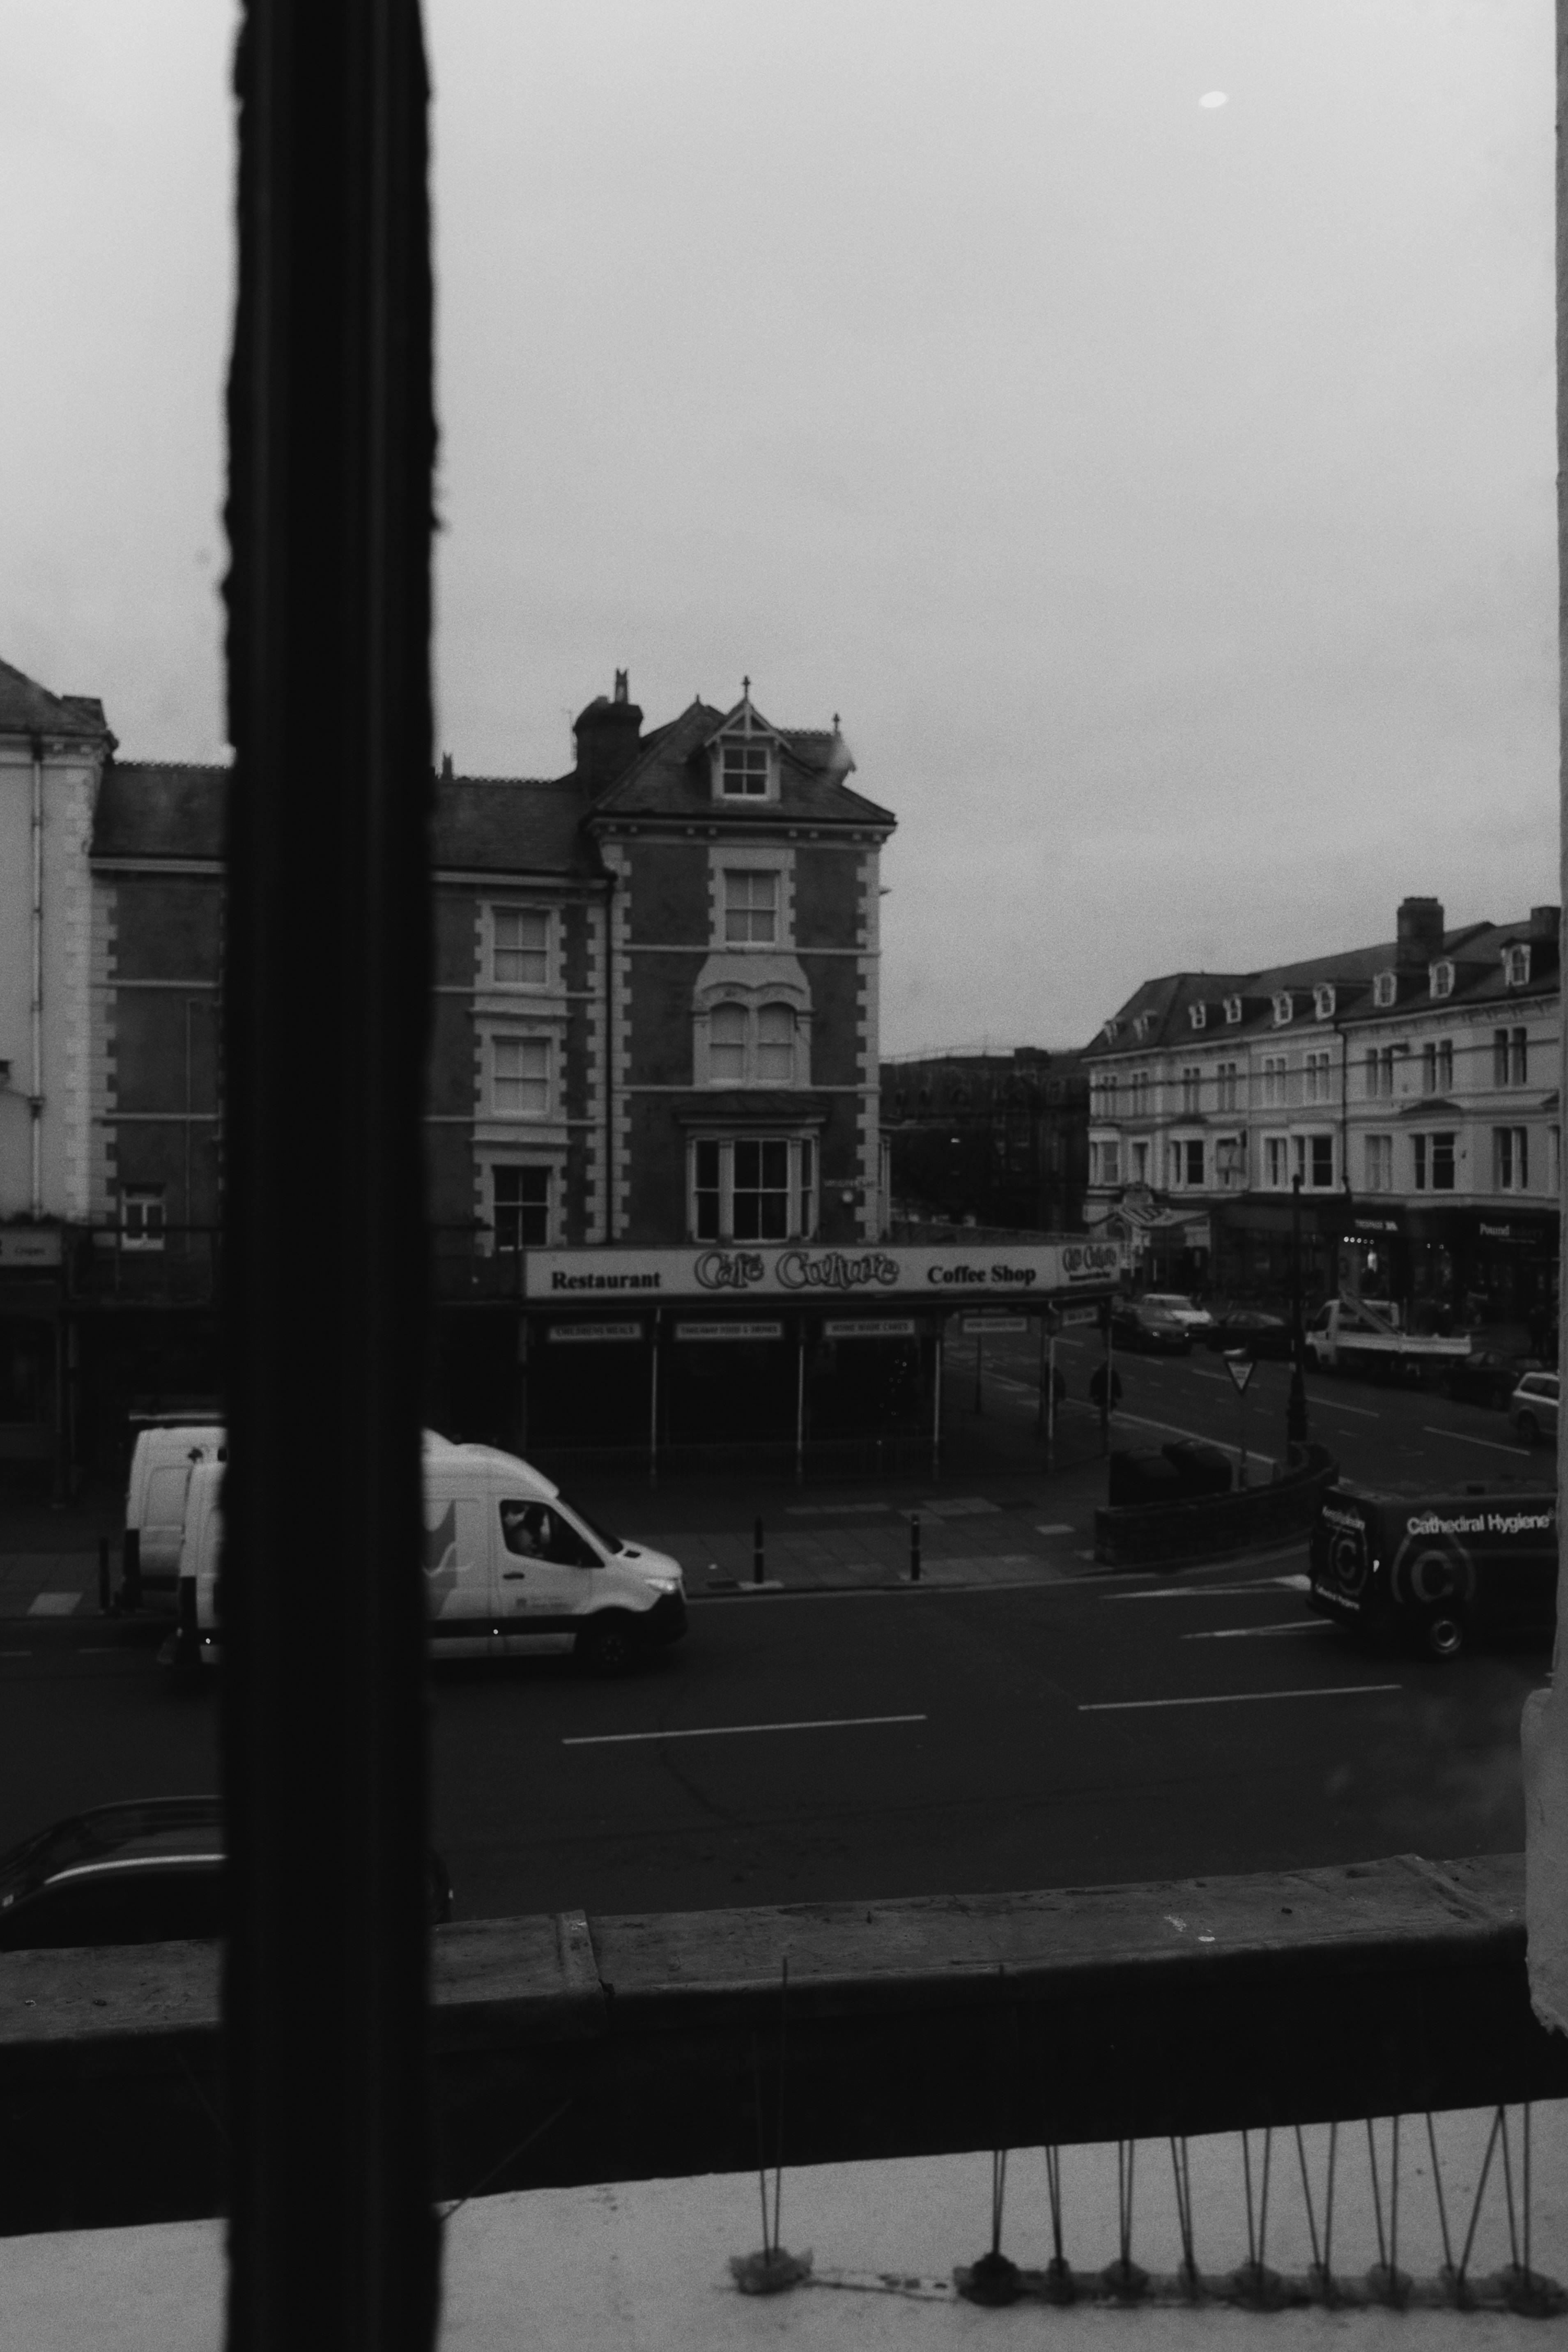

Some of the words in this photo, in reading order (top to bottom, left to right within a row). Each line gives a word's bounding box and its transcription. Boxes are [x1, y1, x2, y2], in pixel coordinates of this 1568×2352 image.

[552, 1271, 661, 1290] Restaurant
[775, 1251, 900, 1290] Culture
[927, 1265, 986, 1284] Coffee
[991, 1265, 1036, 1286] Shop
[1407, 1514, 1485, 1535] Cathedral
[1487, 1512, 1550, 1534] Hygiene
